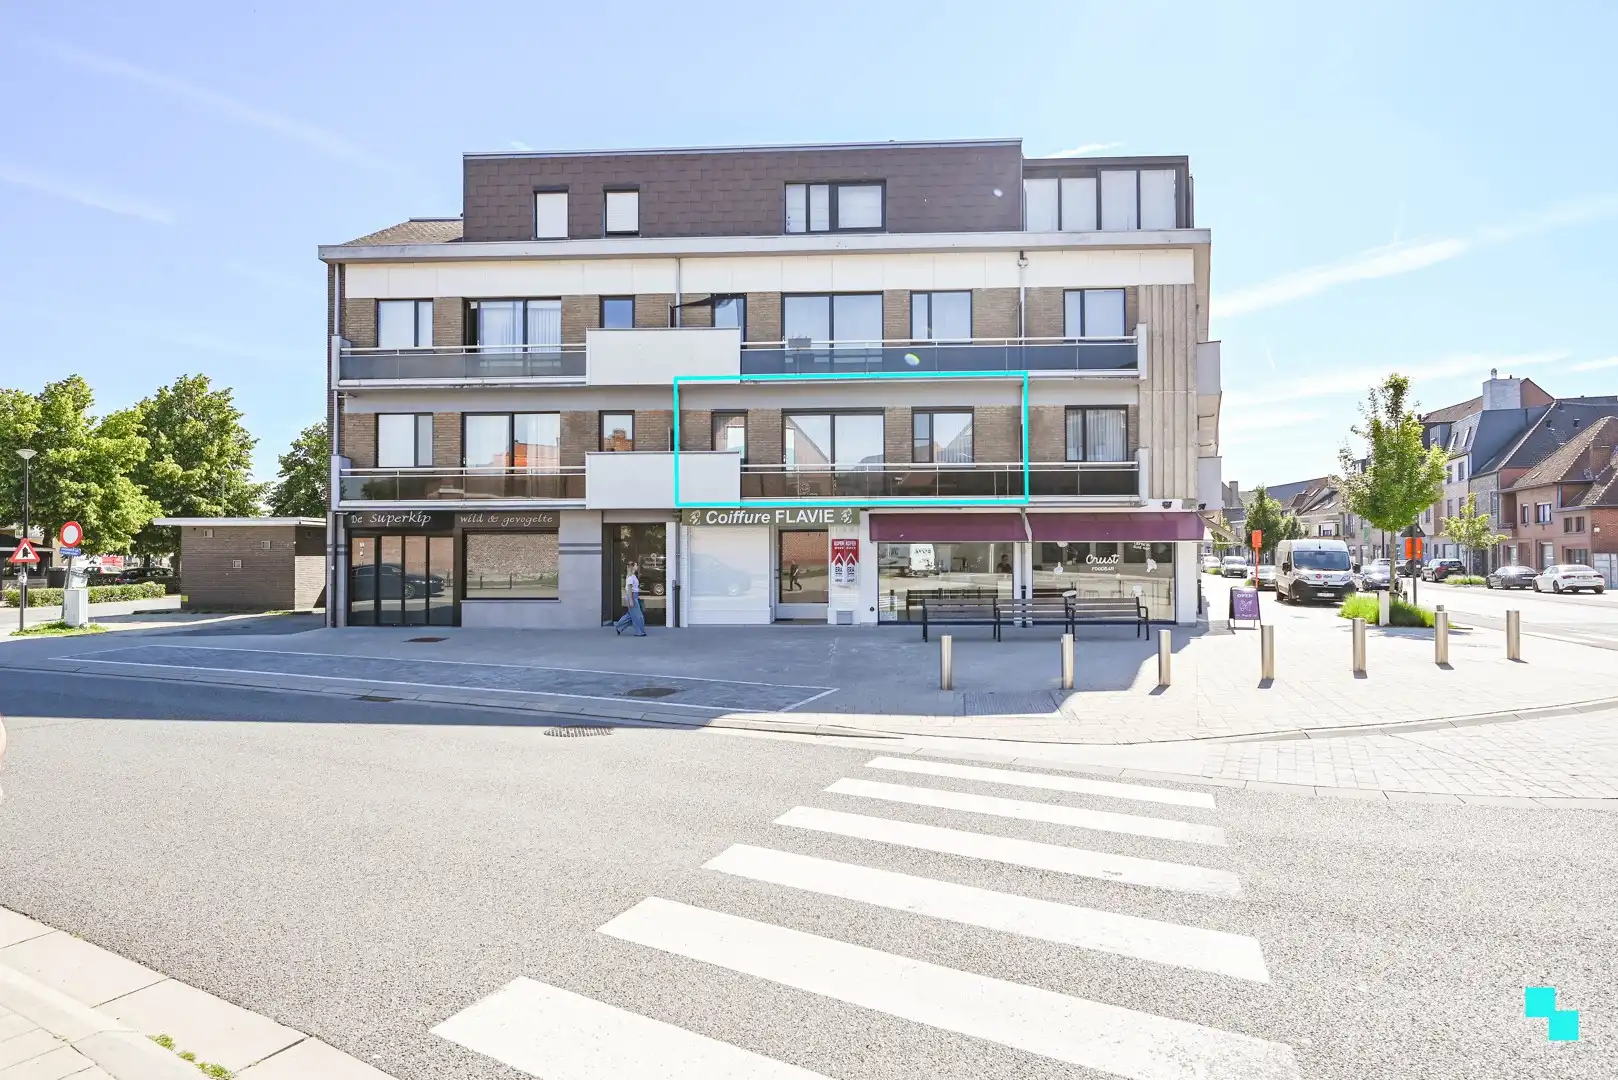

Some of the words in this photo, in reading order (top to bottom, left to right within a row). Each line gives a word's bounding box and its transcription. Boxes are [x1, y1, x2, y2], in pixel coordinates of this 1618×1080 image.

[351, 514, 363, 524] De
[460, 513, 484, 523] wild
[487, 515, 499, 523] &
[501, 512, 553, 527] gevogelte
[705, 510, 771, 524] Coiffure
[775, 509, 835, 523] FLAVIE
[1085, 553, 1120, 565] Crust
